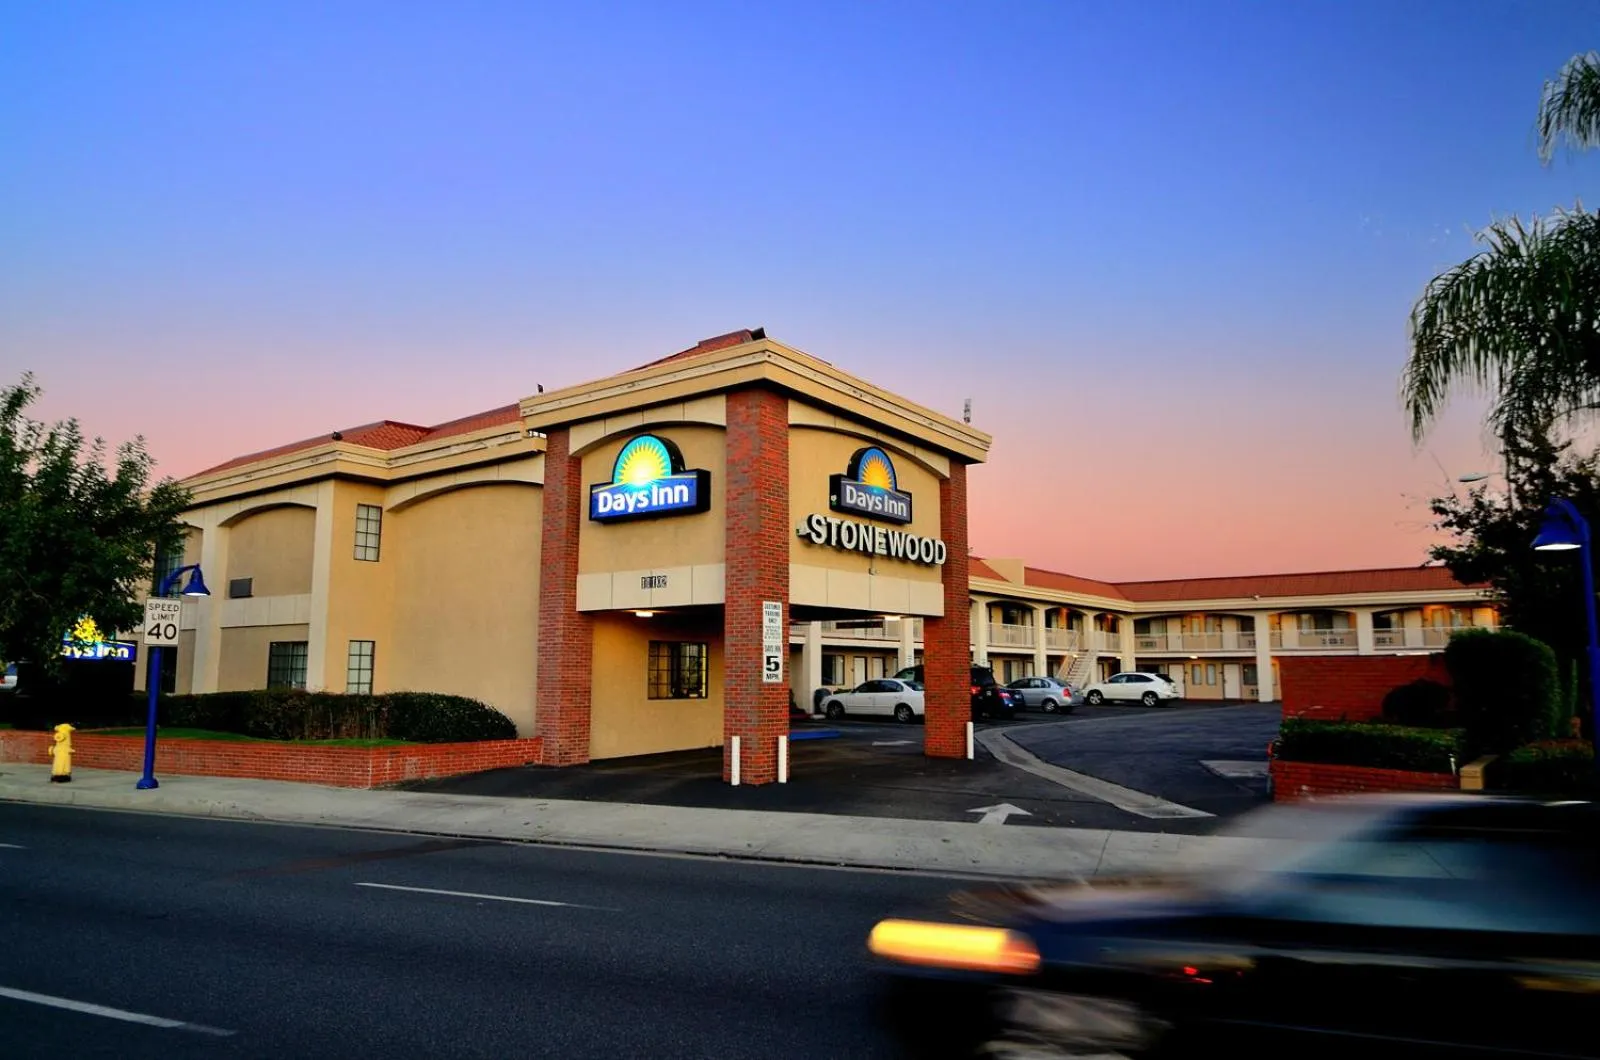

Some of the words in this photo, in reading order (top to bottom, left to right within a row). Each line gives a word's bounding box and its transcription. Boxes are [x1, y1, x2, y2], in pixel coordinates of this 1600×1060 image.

[598, 489, 649, 513] Days
[652, 484, 689, 506] Inn
[846, 485, 882, 511] Days
[884, 491, 907, 517] Inn
[810, 513, 947, 565] STONEWOOD
[148, 602, 180, 612] SPEED
[151, 613, 176, 621] LIMIT
[147, 622, 178, 640] 40
[96, 644, 129, 658] Inn
[766, 655, 780, 672] 5
